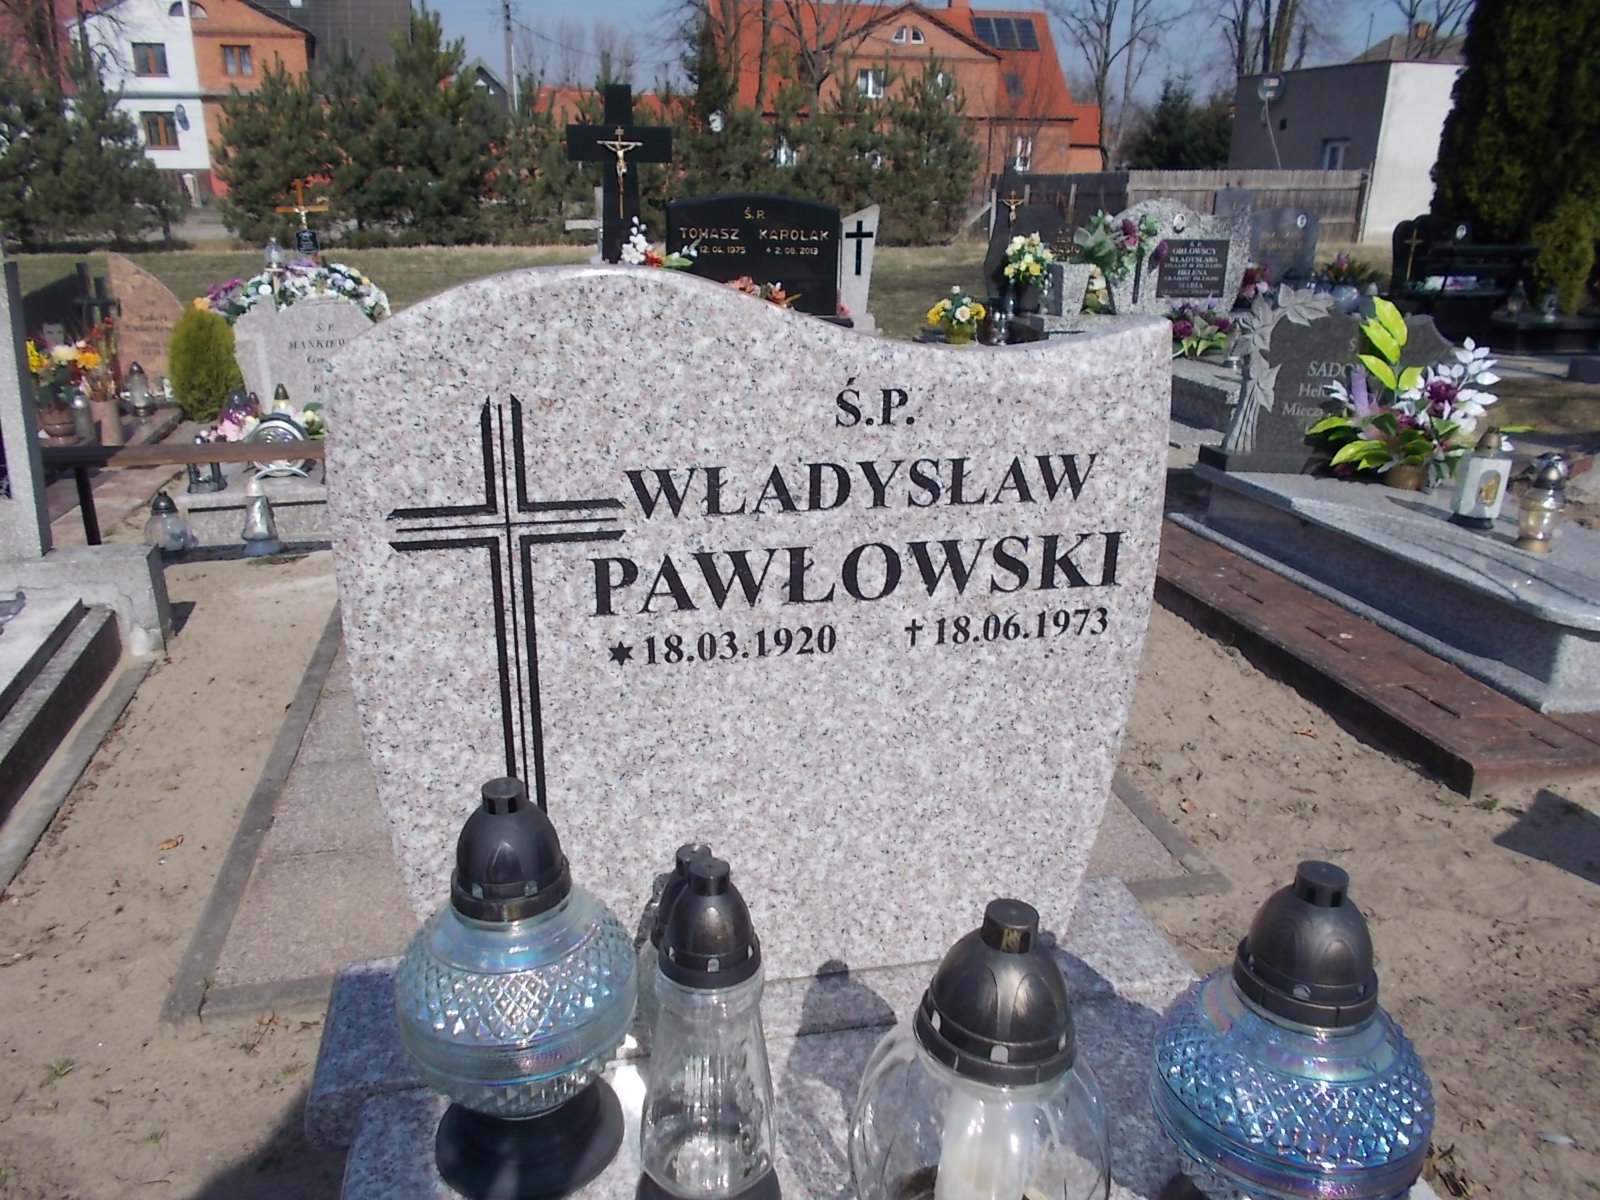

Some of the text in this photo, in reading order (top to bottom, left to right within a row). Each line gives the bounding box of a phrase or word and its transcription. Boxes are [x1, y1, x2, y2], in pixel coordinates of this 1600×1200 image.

[679, 227, 829, 241] TOMASZ KAROLAK
[799, 247, 819, 256] 2013
[835, 377, 915, 428] Ś.P.
[623, 453, 1099, 520] WŁADYSŁAW
[588, 531, 1127, 617] PAWŁOWSKI
[646, 606, 1109, 665] 18.03.1920 18.06.1973
